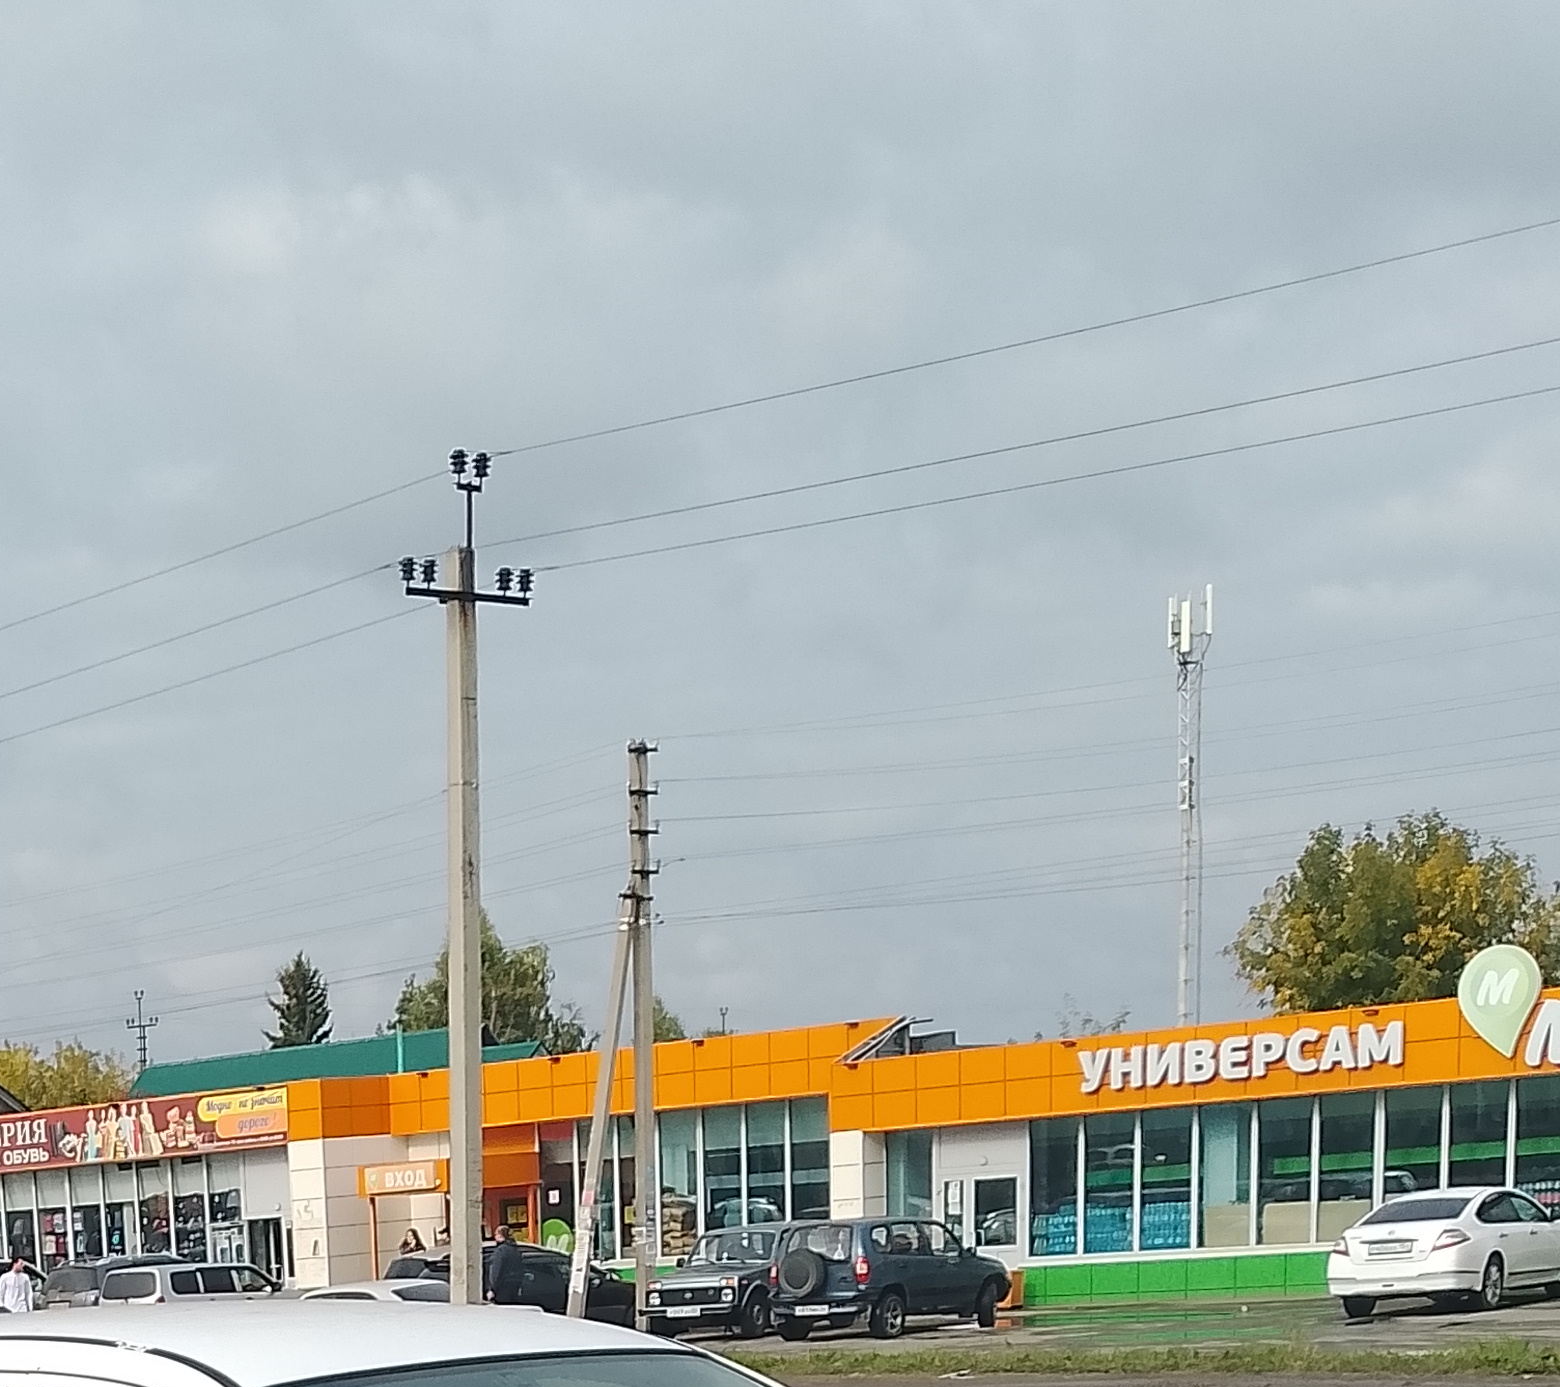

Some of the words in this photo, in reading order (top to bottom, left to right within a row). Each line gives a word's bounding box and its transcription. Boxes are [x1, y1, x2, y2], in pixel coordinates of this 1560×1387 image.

[1078, 1021, 1405, 1093] УНИВЕРСАМ
[3, 1147, 50, 1166] ОБУВЬ
[385, 1169, 427, 1188] ВХОД
